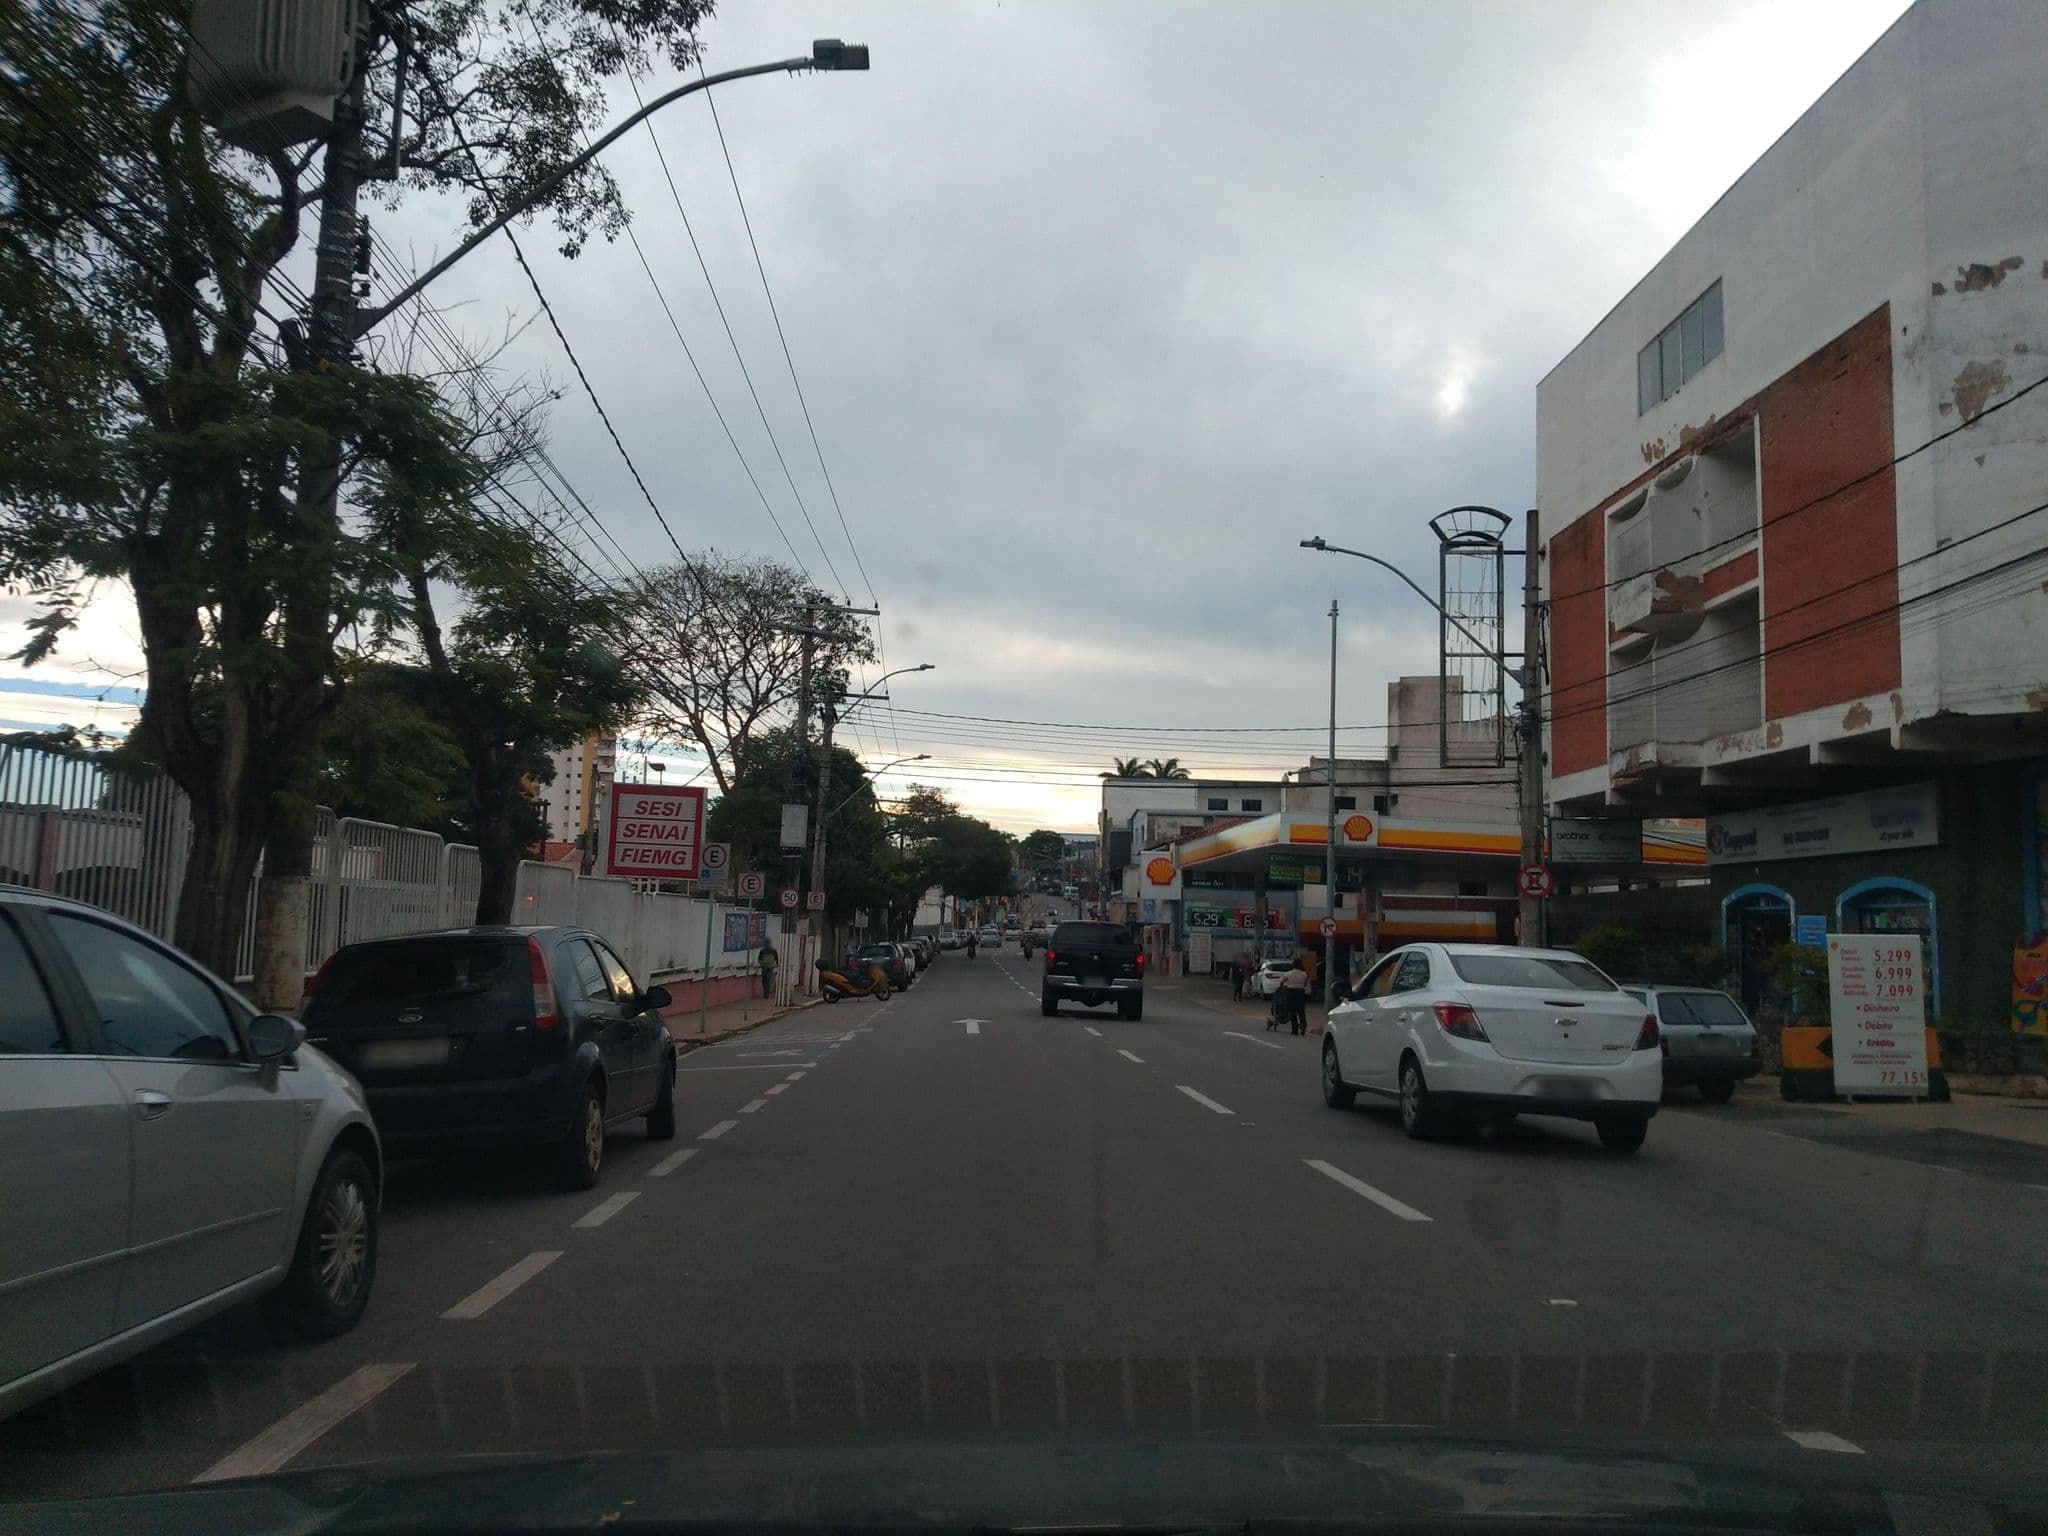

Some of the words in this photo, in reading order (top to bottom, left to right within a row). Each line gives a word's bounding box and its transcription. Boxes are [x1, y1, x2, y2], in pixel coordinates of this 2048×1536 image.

[635, 800, 682, 817] SESI
[623, 823, 688, 841] SENAI
[620, 847, 687, 865] FIEMG
[710, 850, 719, 863] E
[747, 878, 756, 890] E
[784, 892, 796, 903] 50
[1874, 949, 1912, 963] 5.299
[1875, 967, 1913, 980] 6.999
[1876, 984, 1914, 997] 7.099
